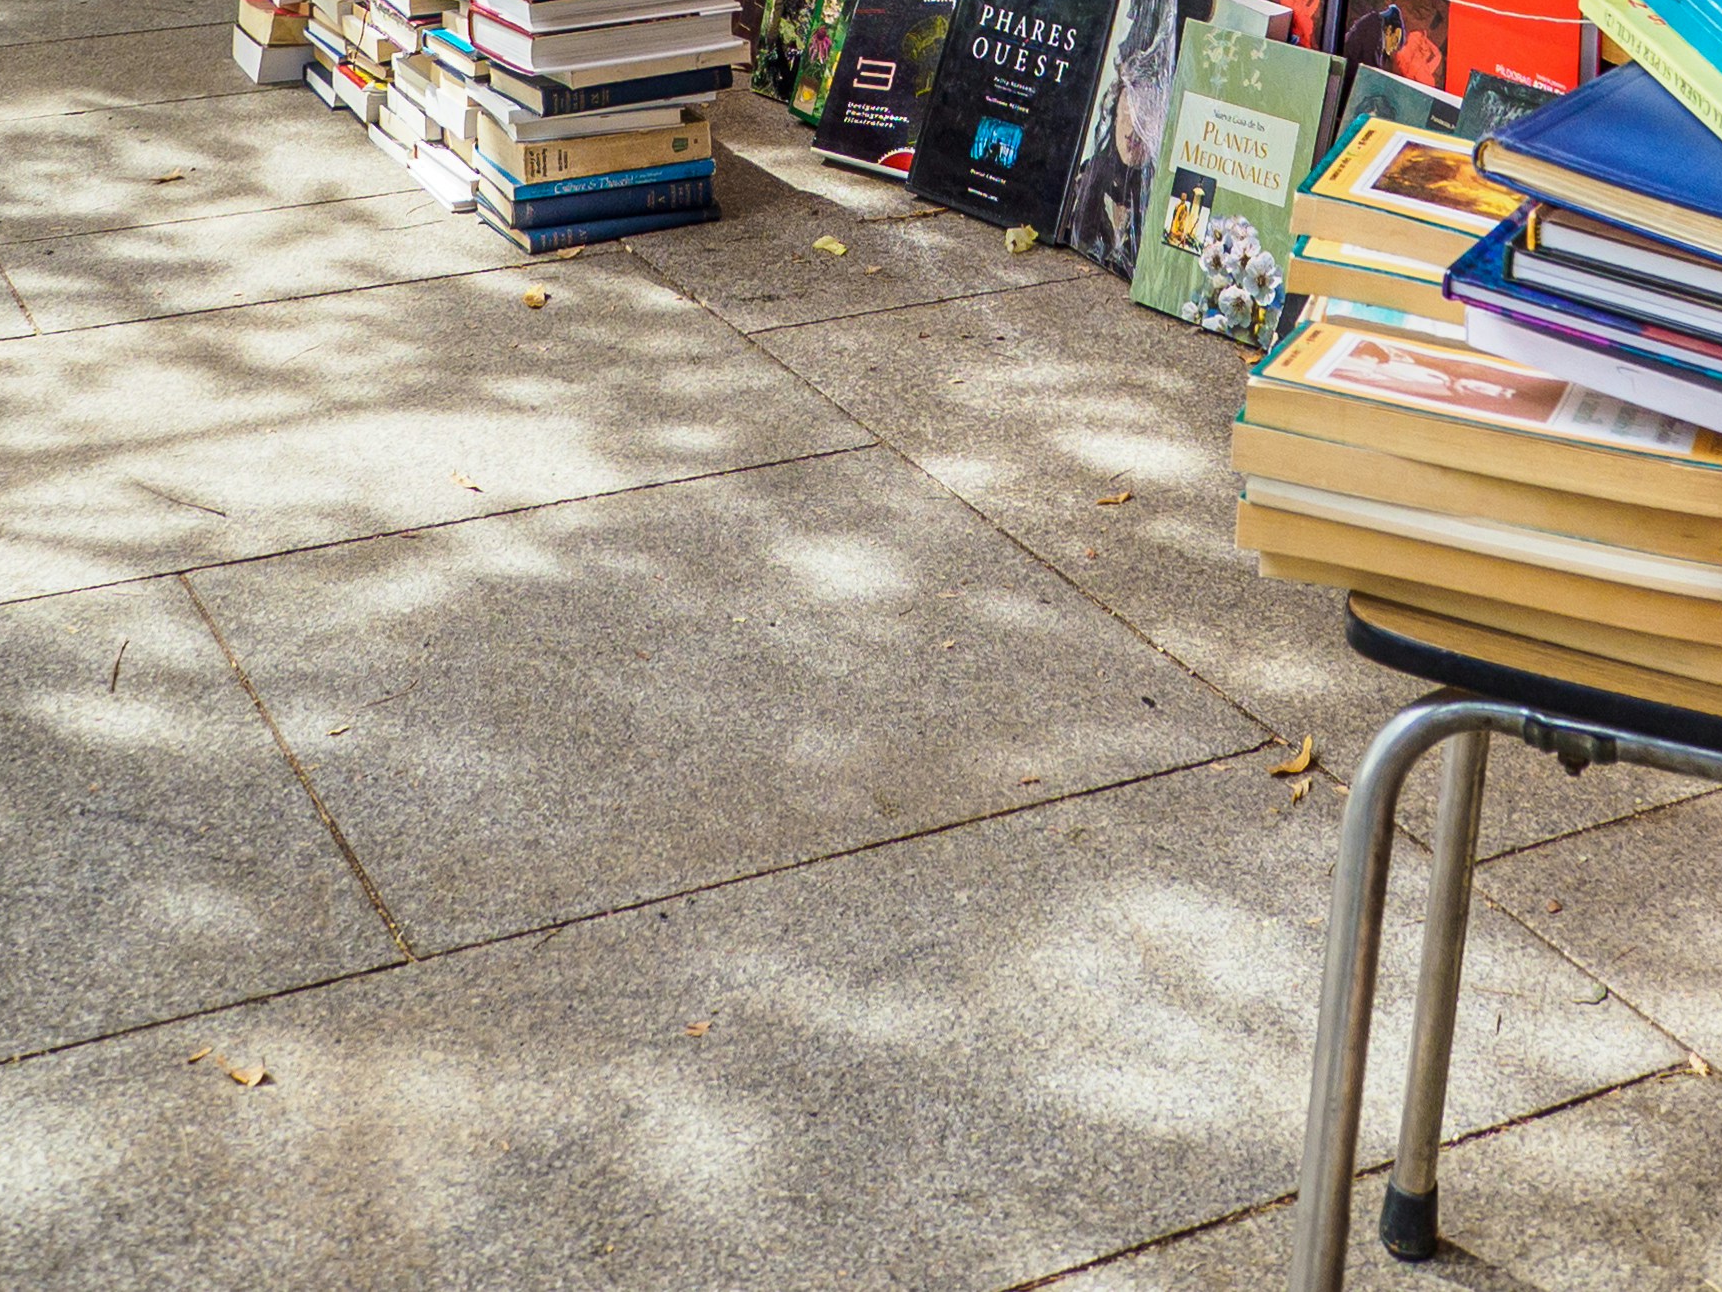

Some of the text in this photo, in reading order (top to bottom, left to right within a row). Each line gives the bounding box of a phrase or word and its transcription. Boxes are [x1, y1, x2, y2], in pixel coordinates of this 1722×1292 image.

[979, 3, 1077, 51] PHARES
[972, 36, 1069, 84] OUEST
[1203, 121, 1268, 159] PLANTAS
[1180, 140, 1281, 190] MEDICINALES
